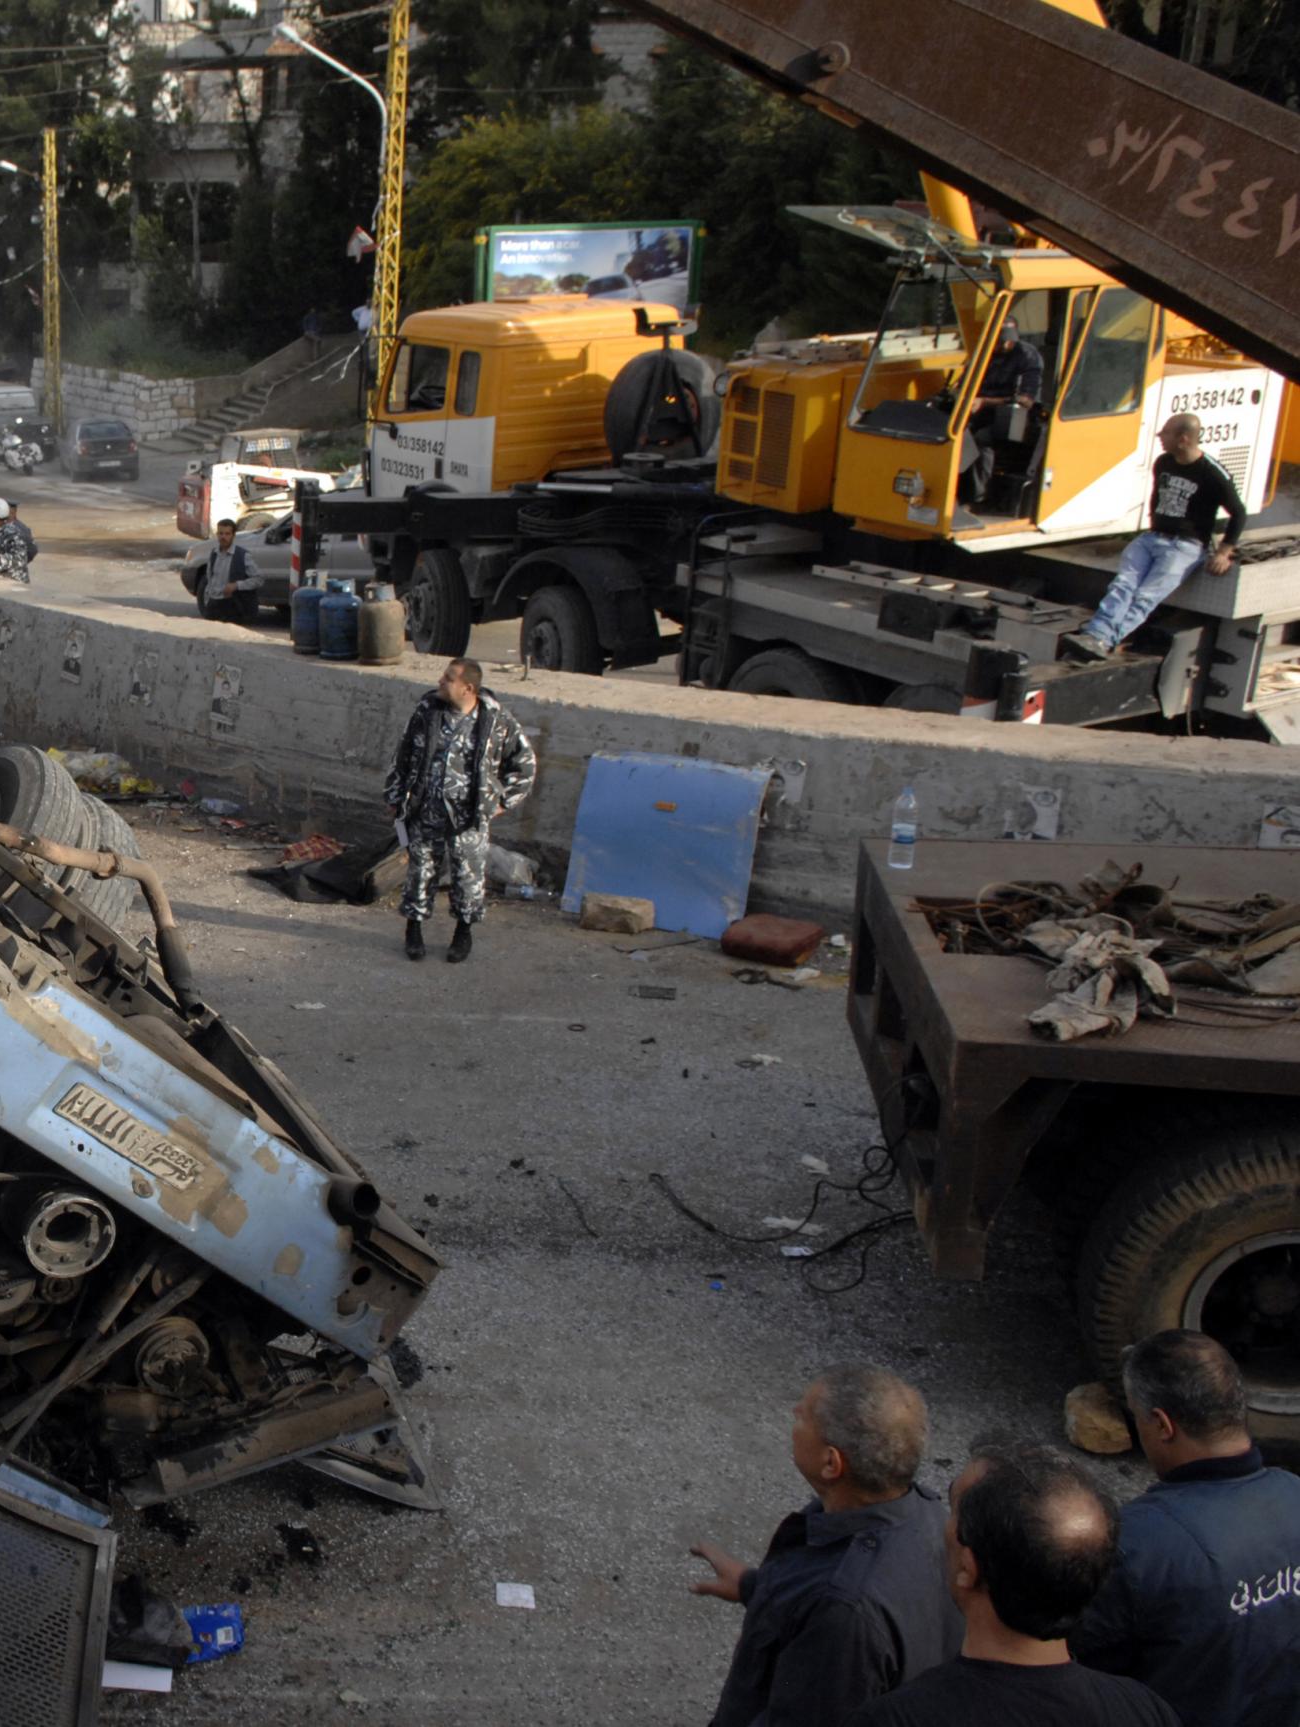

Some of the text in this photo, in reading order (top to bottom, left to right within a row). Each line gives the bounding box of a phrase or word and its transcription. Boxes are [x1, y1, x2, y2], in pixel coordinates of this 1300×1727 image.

[501, 240, 528, 252] More
[530, 238, 555, 251] than
[500, 253, 516, 265] An
[1170, 387, 1245, 413] 03/358142
[397, 435, 445, 456] 03/358142
[381, 457, 424, 480] 03/323531
